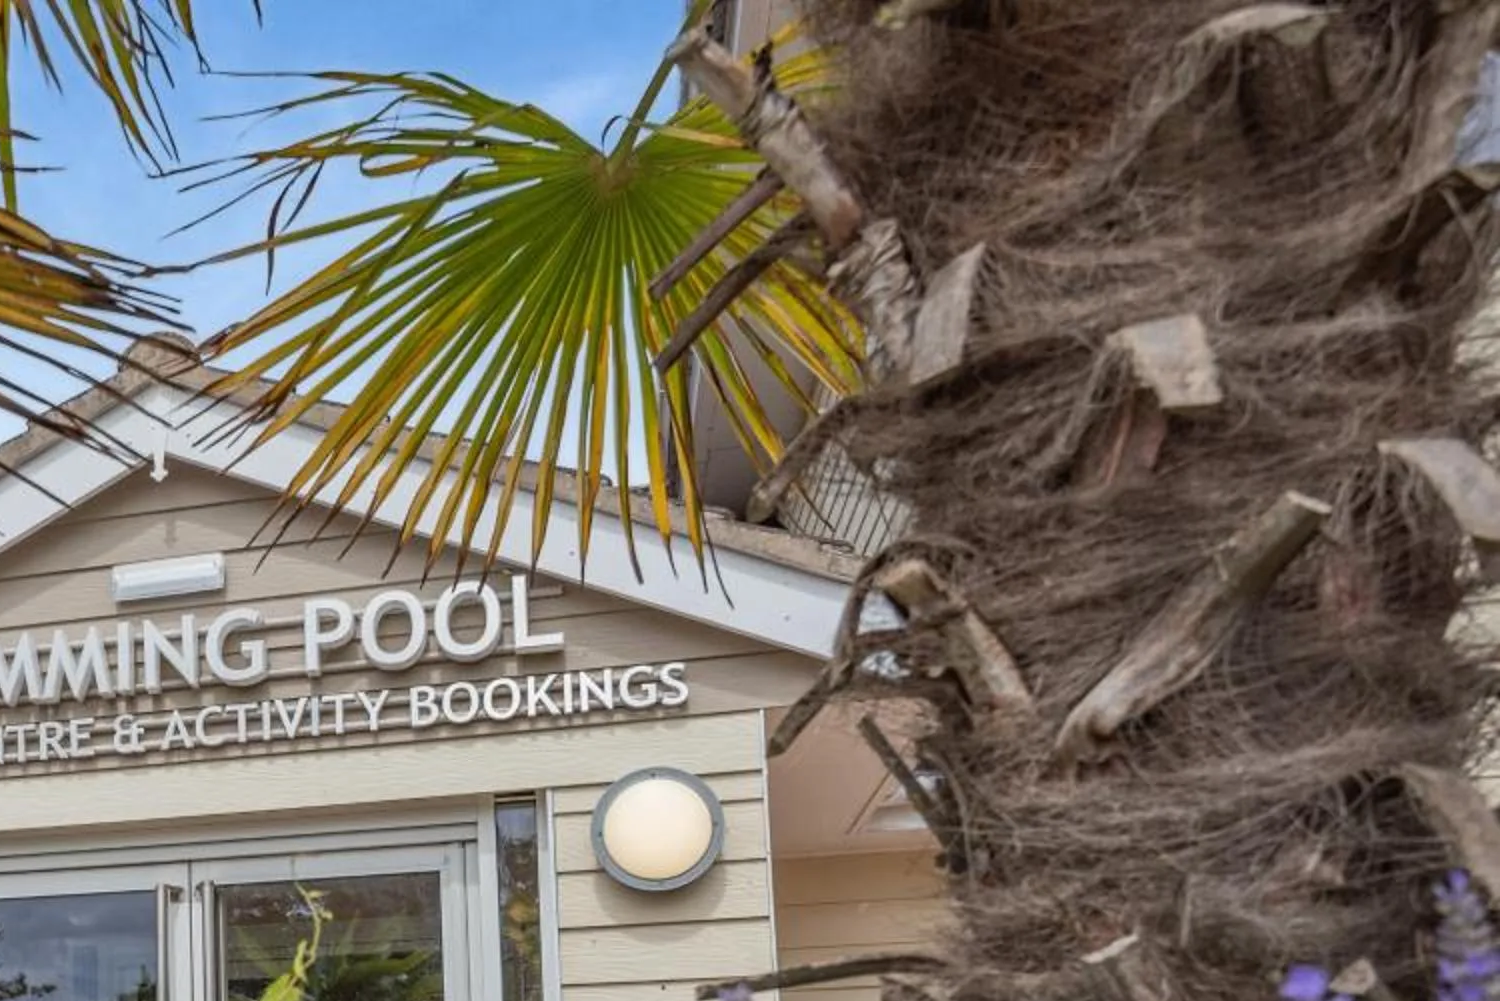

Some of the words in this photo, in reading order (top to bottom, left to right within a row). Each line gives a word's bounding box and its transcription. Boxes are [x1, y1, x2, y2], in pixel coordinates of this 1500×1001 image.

[303, 574, 565, 678] POOL
[113, 713, 146, 754] &
[161, 690, 389, 751] ACTIVITY
[409, 662, 690, 728] BOOKINGS
